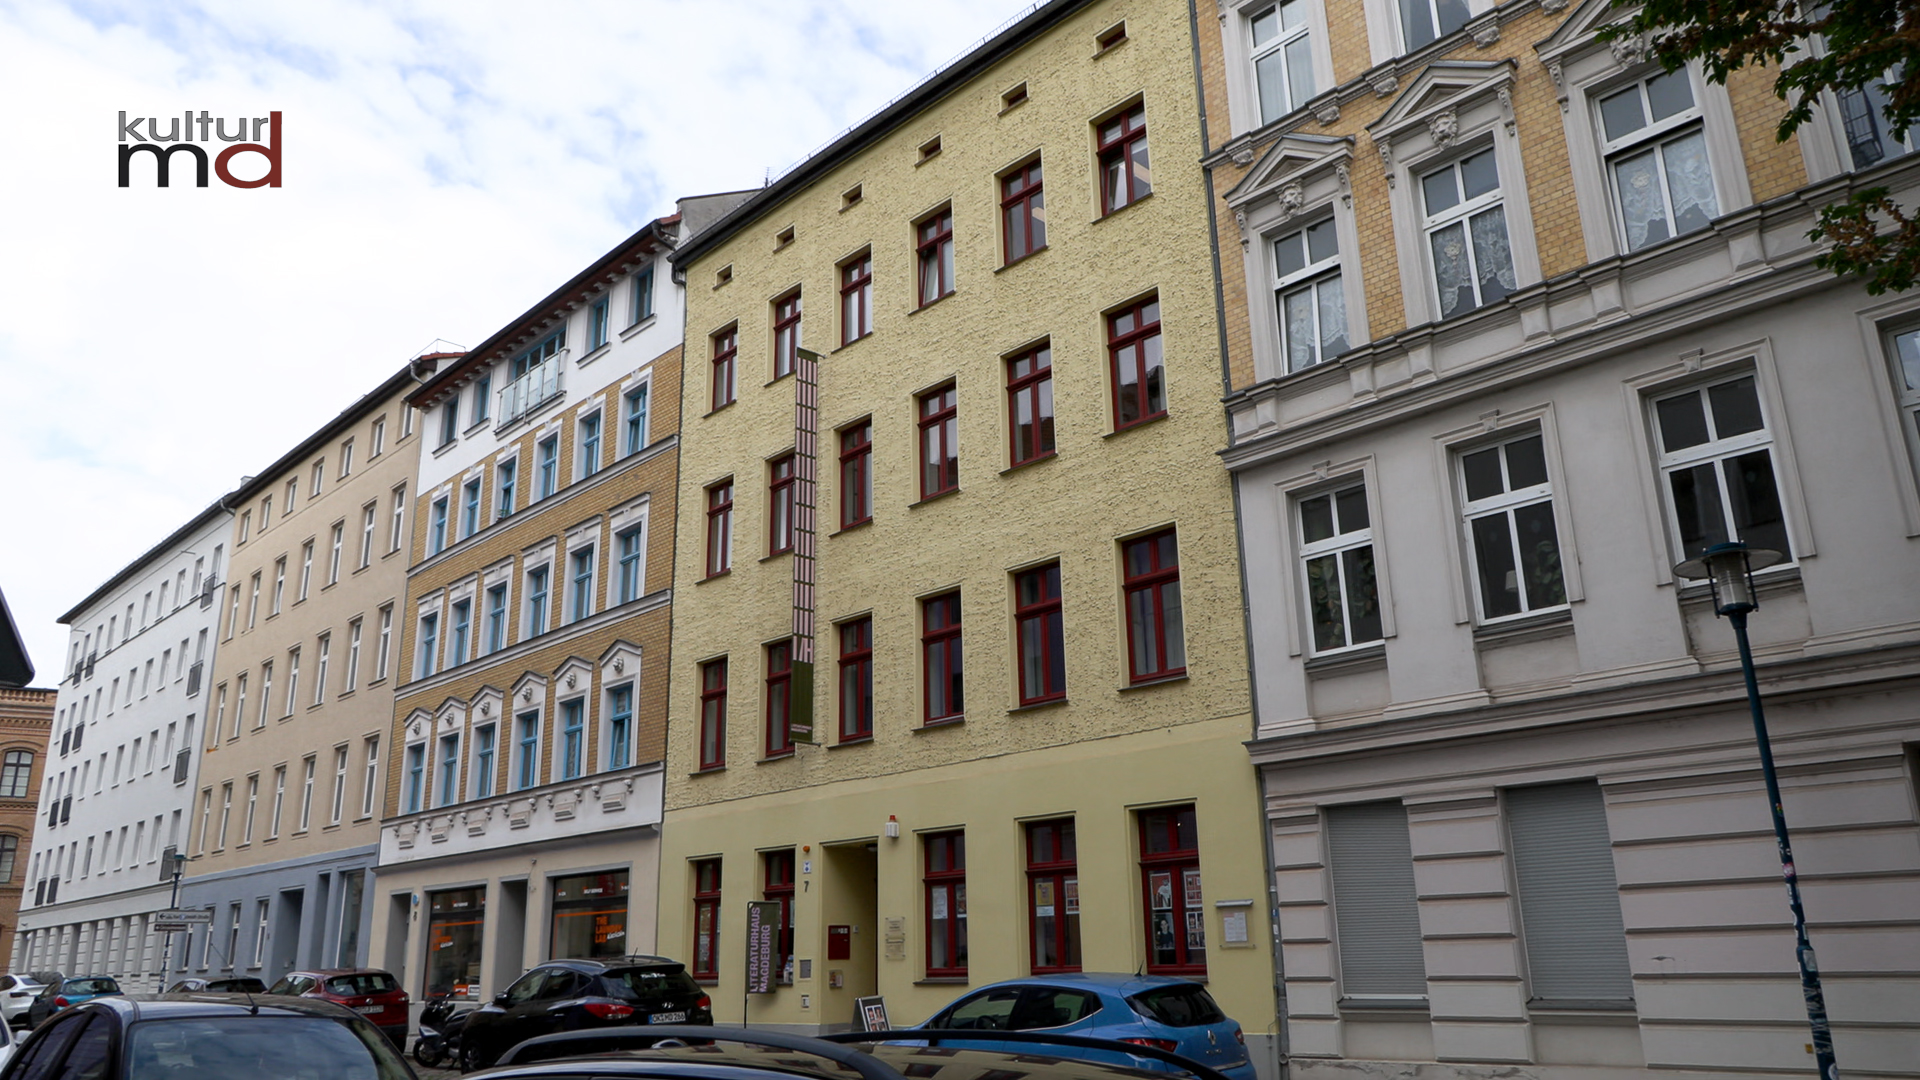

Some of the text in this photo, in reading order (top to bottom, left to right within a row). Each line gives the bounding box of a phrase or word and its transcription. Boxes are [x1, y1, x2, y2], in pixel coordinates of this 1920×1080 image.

[804, 881, 809, 892] 7
[750, 907, 760, 993] LITERATURHAUS
[760, 925, 770, 993] MAGDEBURG
